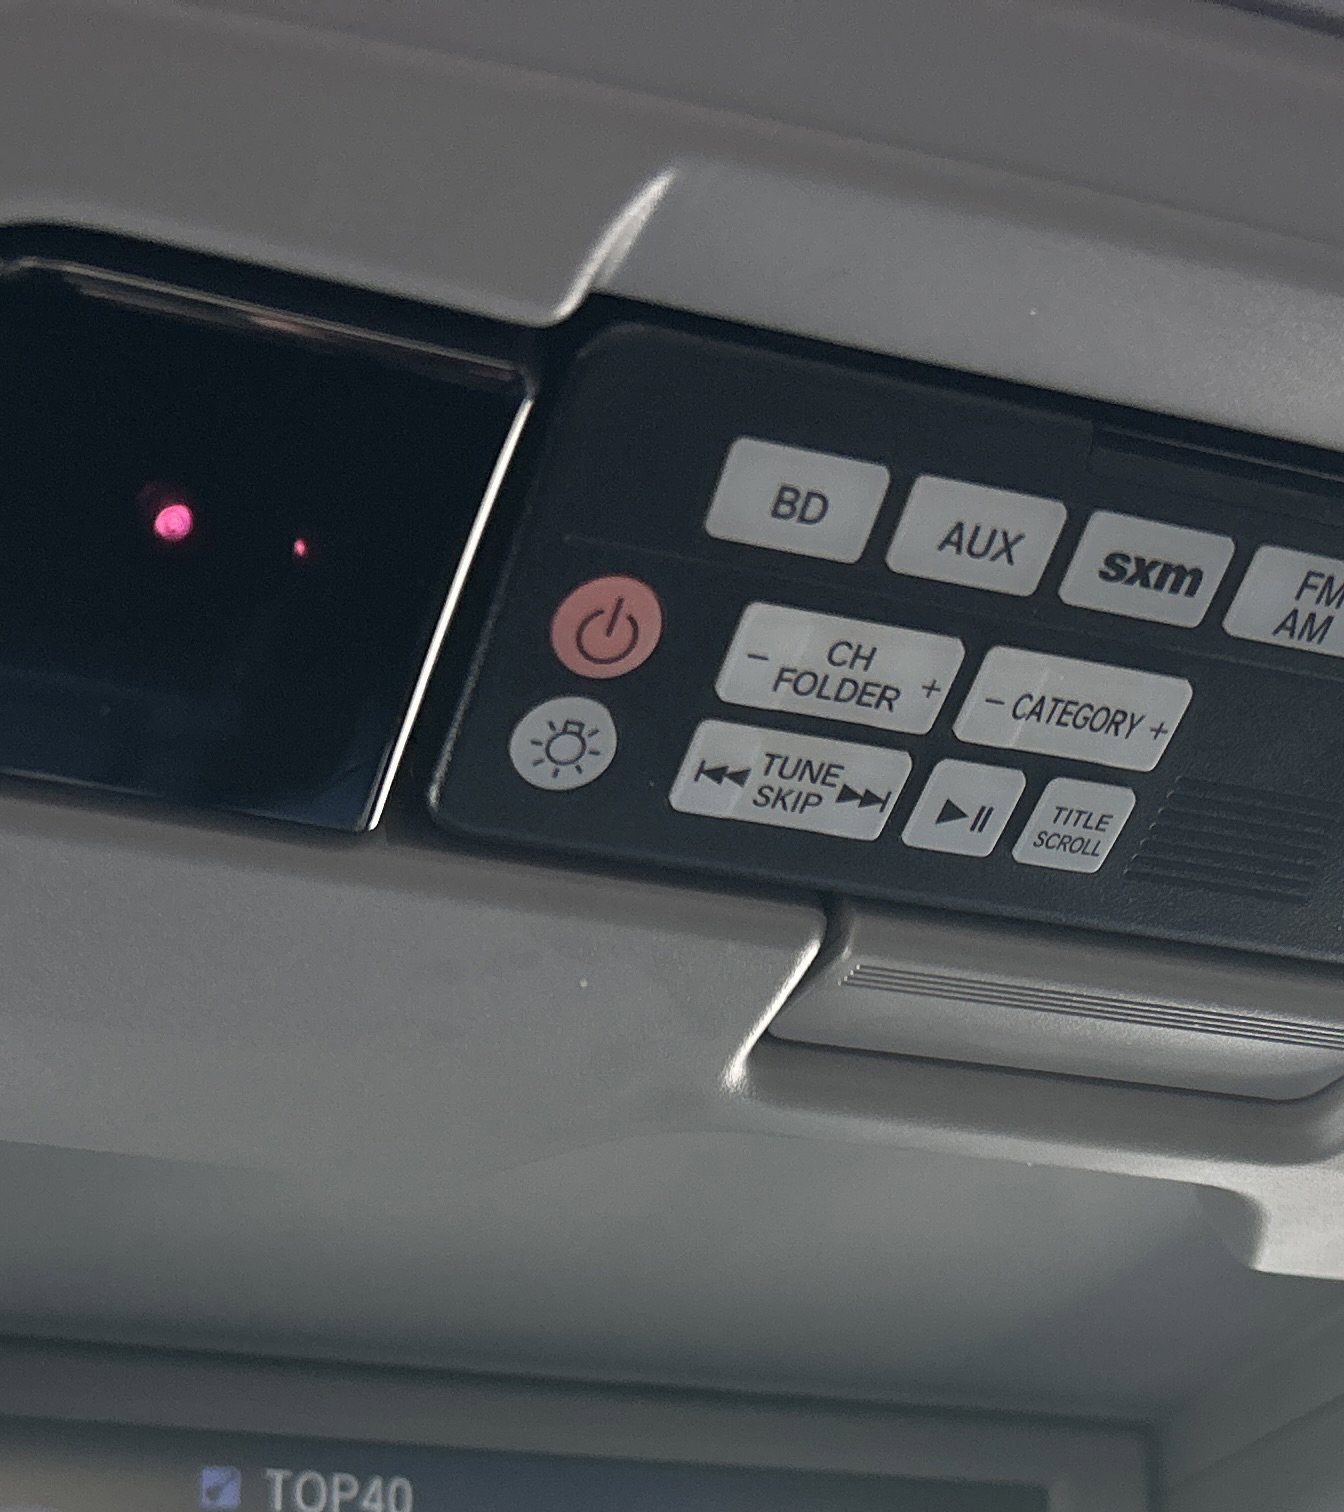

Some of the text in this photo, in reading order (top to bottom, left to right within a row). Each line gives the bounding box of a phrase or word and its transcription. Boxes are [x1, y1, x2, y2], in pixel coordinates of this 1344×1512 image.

[771, 484, 829, 526] BD
[938, 520, 1025, 568] AUX
[1272, 610, 1332, 645] AM
[826, 639, 877, 674] CH
[772, 666, 902, 714] FOLDER
[1011, 693, 1143, 741] CATEGORY
[760, 753, 846, 790] TUNE
[752, 785, 824, 816] SKIP
[1053, 805, 1114, 833] TITLE
[1032, 830, 1101, 858] SCROLL
